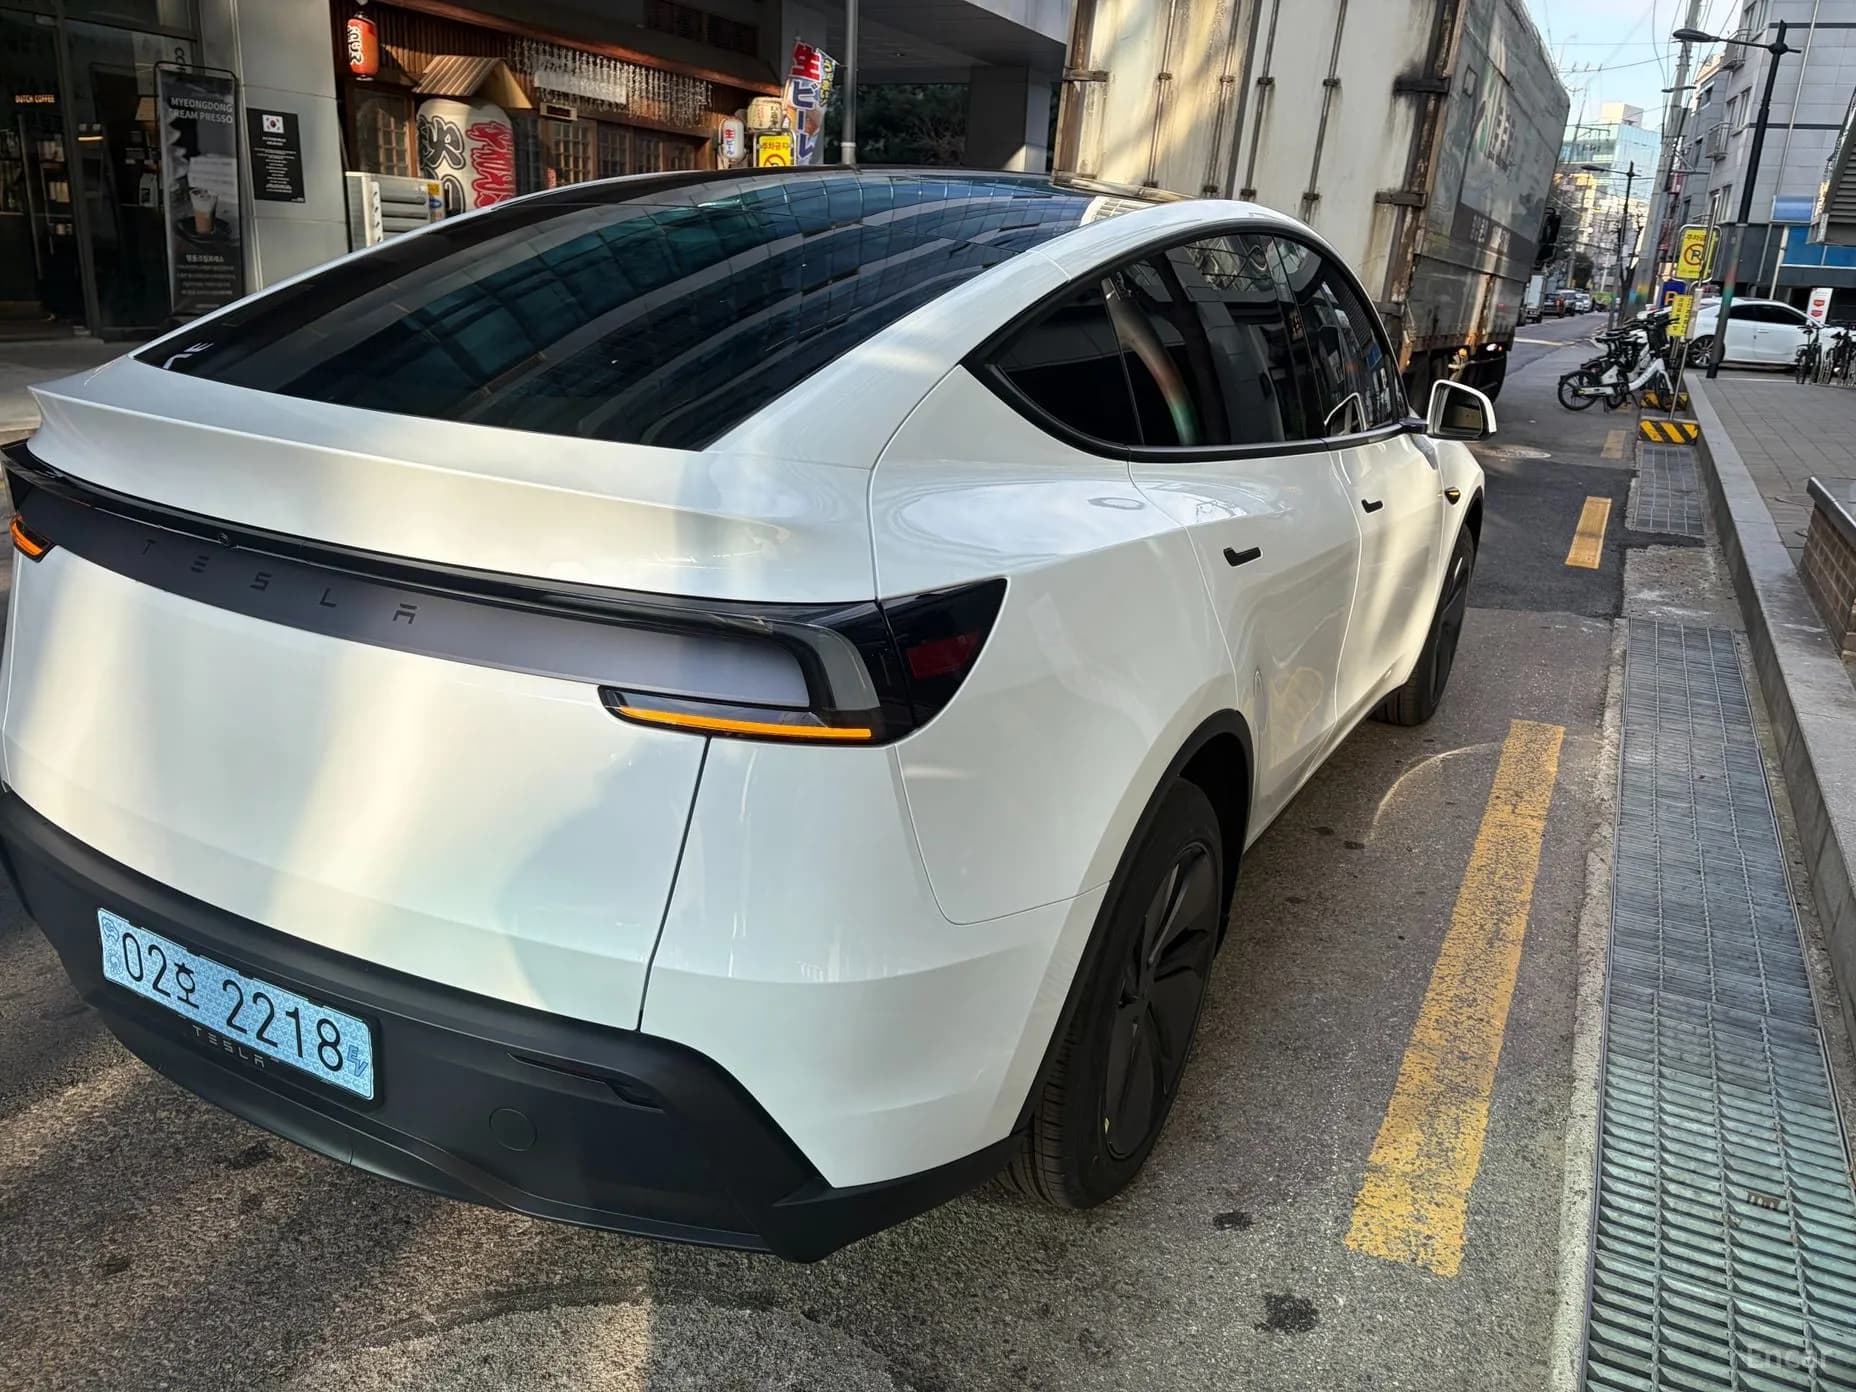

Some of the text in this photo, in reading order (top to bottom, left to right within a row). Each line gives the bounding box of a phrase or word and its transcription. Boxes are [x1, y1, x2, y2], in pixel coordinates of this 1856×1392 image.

[170, 97, 233, 113] MYEONGDONG
[141, 539, 417, 625] TESLA
[122, 932, 344, 1073] 02호 2218
[192, 1024, 266, 1069] TESLA
[346, 1044, 368, 1078] EV
